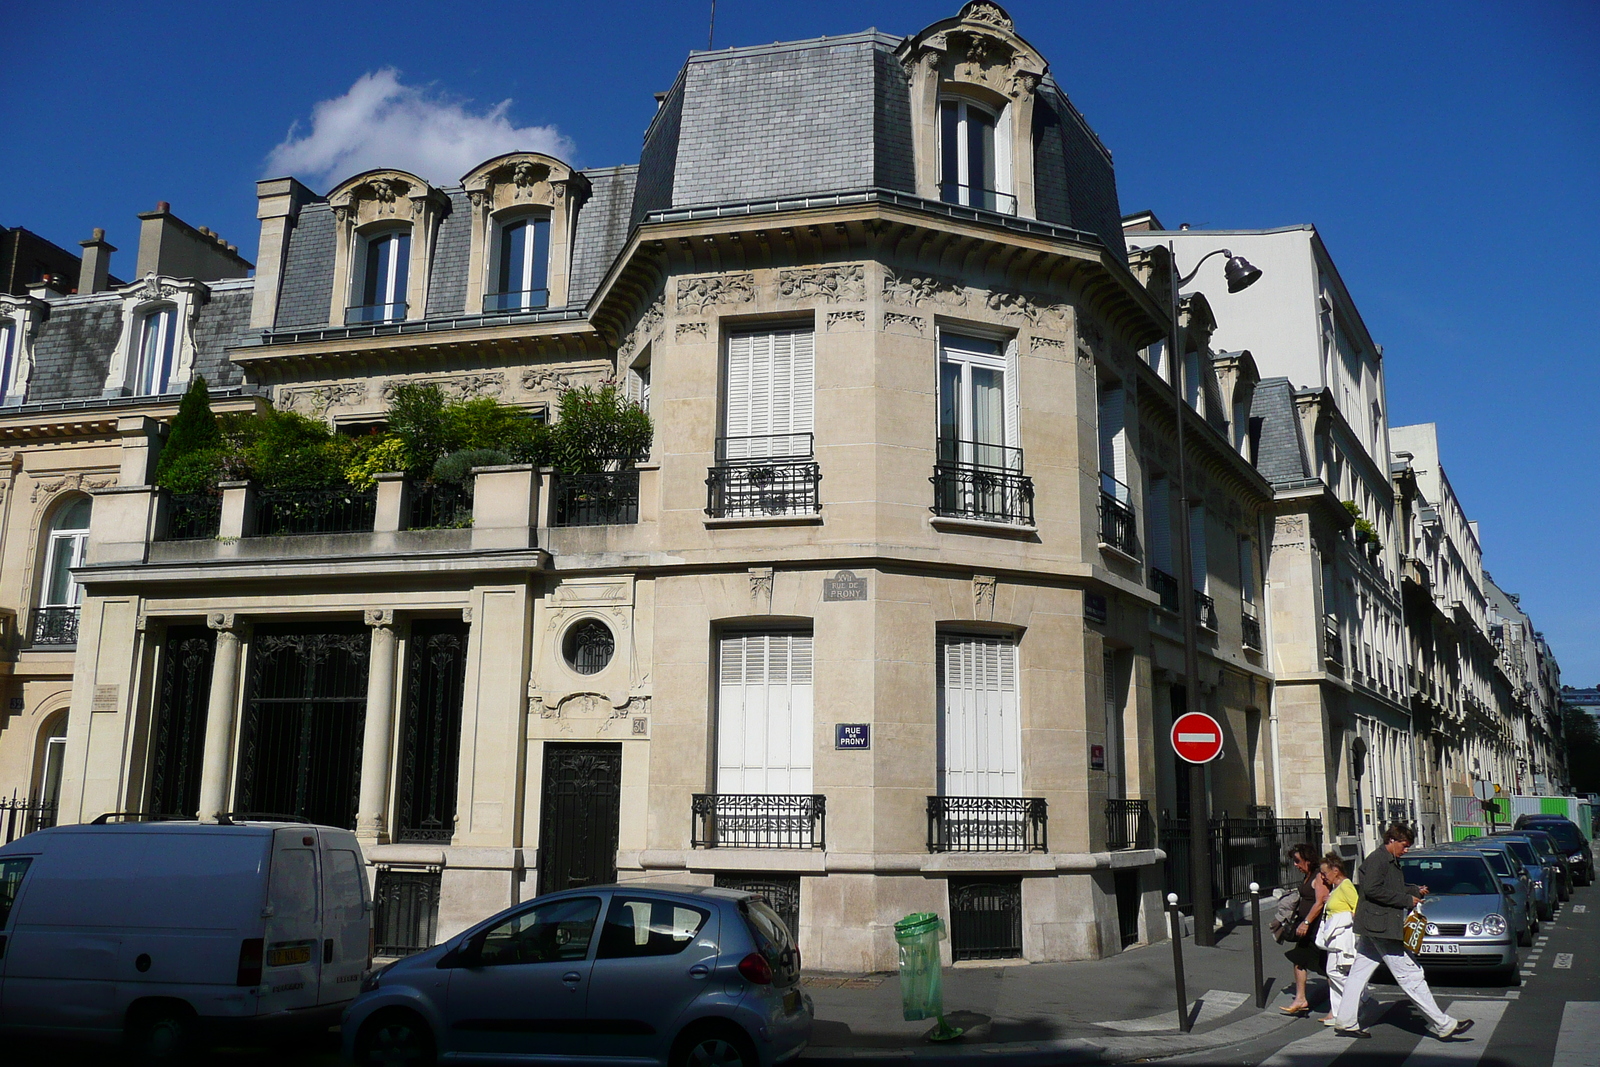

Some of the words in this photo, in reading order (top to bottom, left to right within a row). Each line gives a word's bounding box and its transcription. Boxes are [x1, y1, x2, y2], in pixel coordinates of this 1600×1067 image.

[830, 590, 861, 598] PRONY
[633, 720, 646, 732] 30
[1435, 945, 1444, 953] ZN
[1448, 945, 1458, 953] 93
